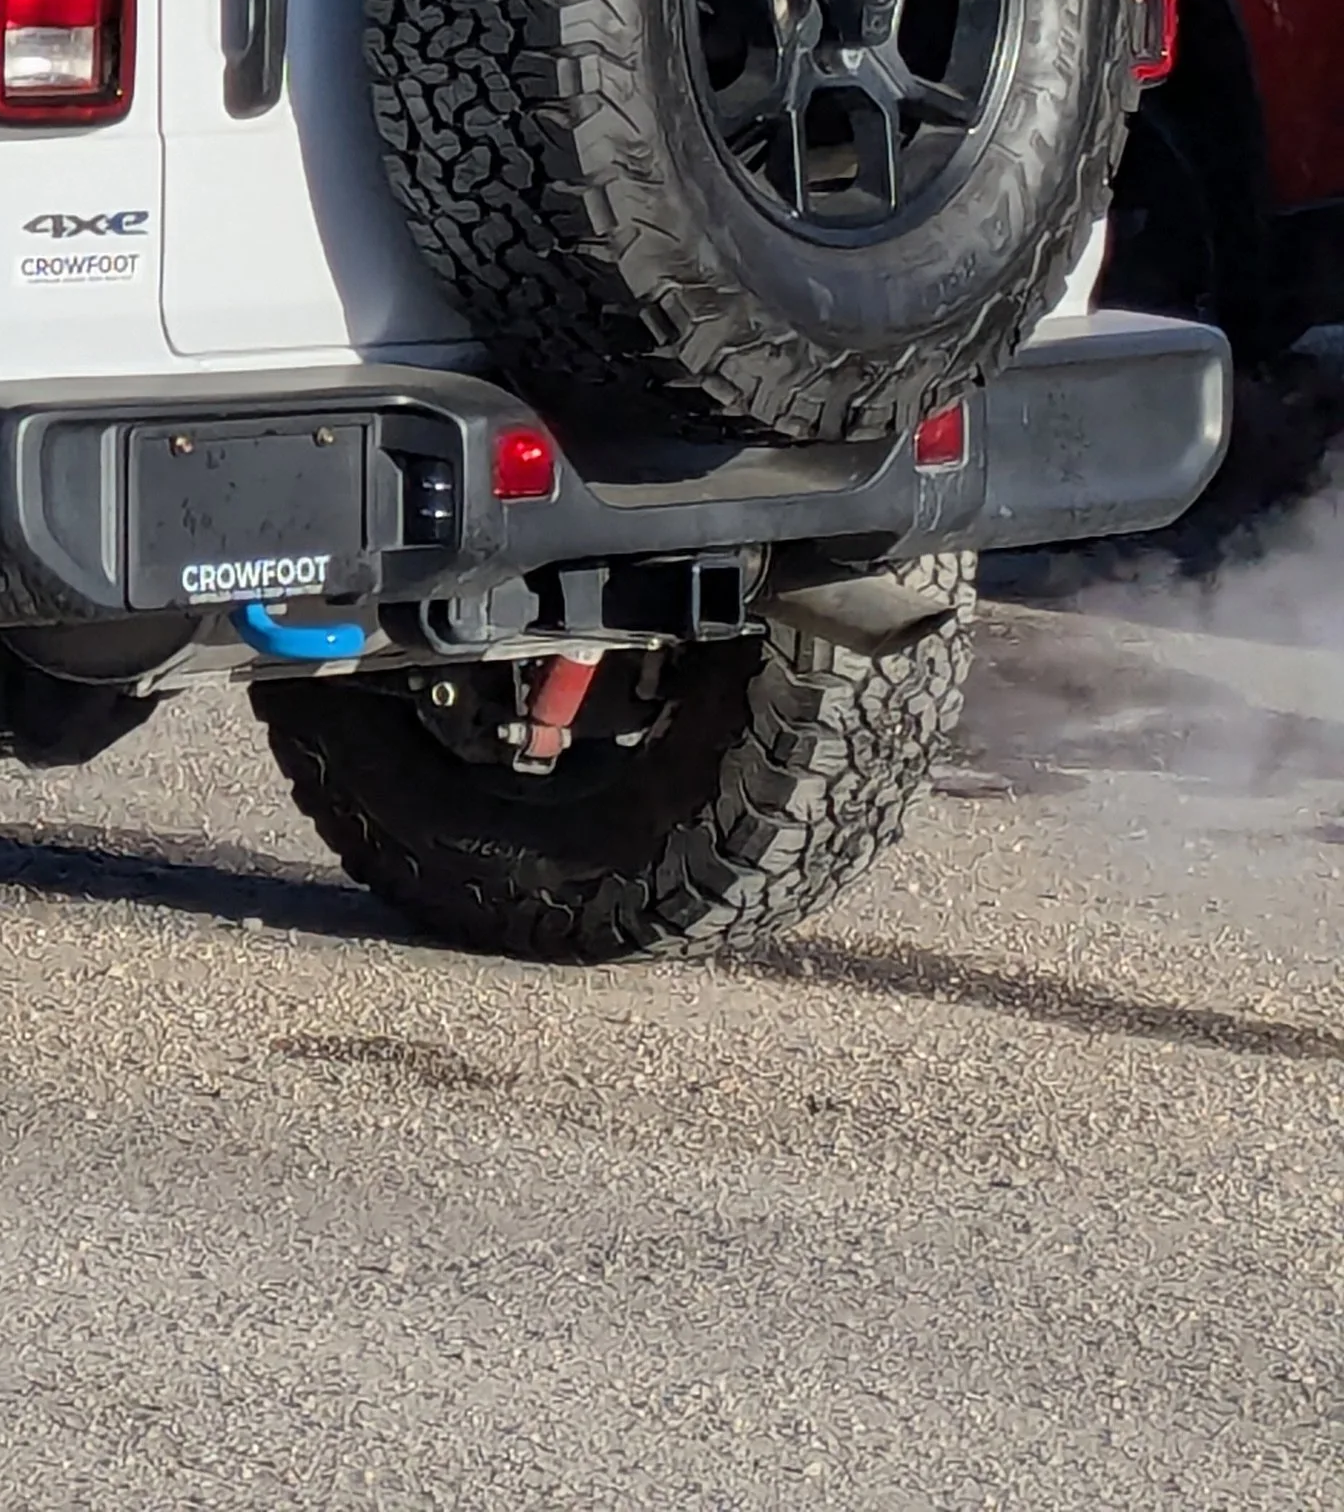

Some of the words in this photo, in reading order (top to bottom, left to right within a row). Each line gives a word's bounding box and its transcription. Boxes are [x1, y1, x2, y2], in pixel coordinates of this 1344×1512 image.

[22, 210, 150, 239] 4xe
[20, 254, 140, 276] CROWFOOT
[182, 554, 331, 591] CROWFOOT
